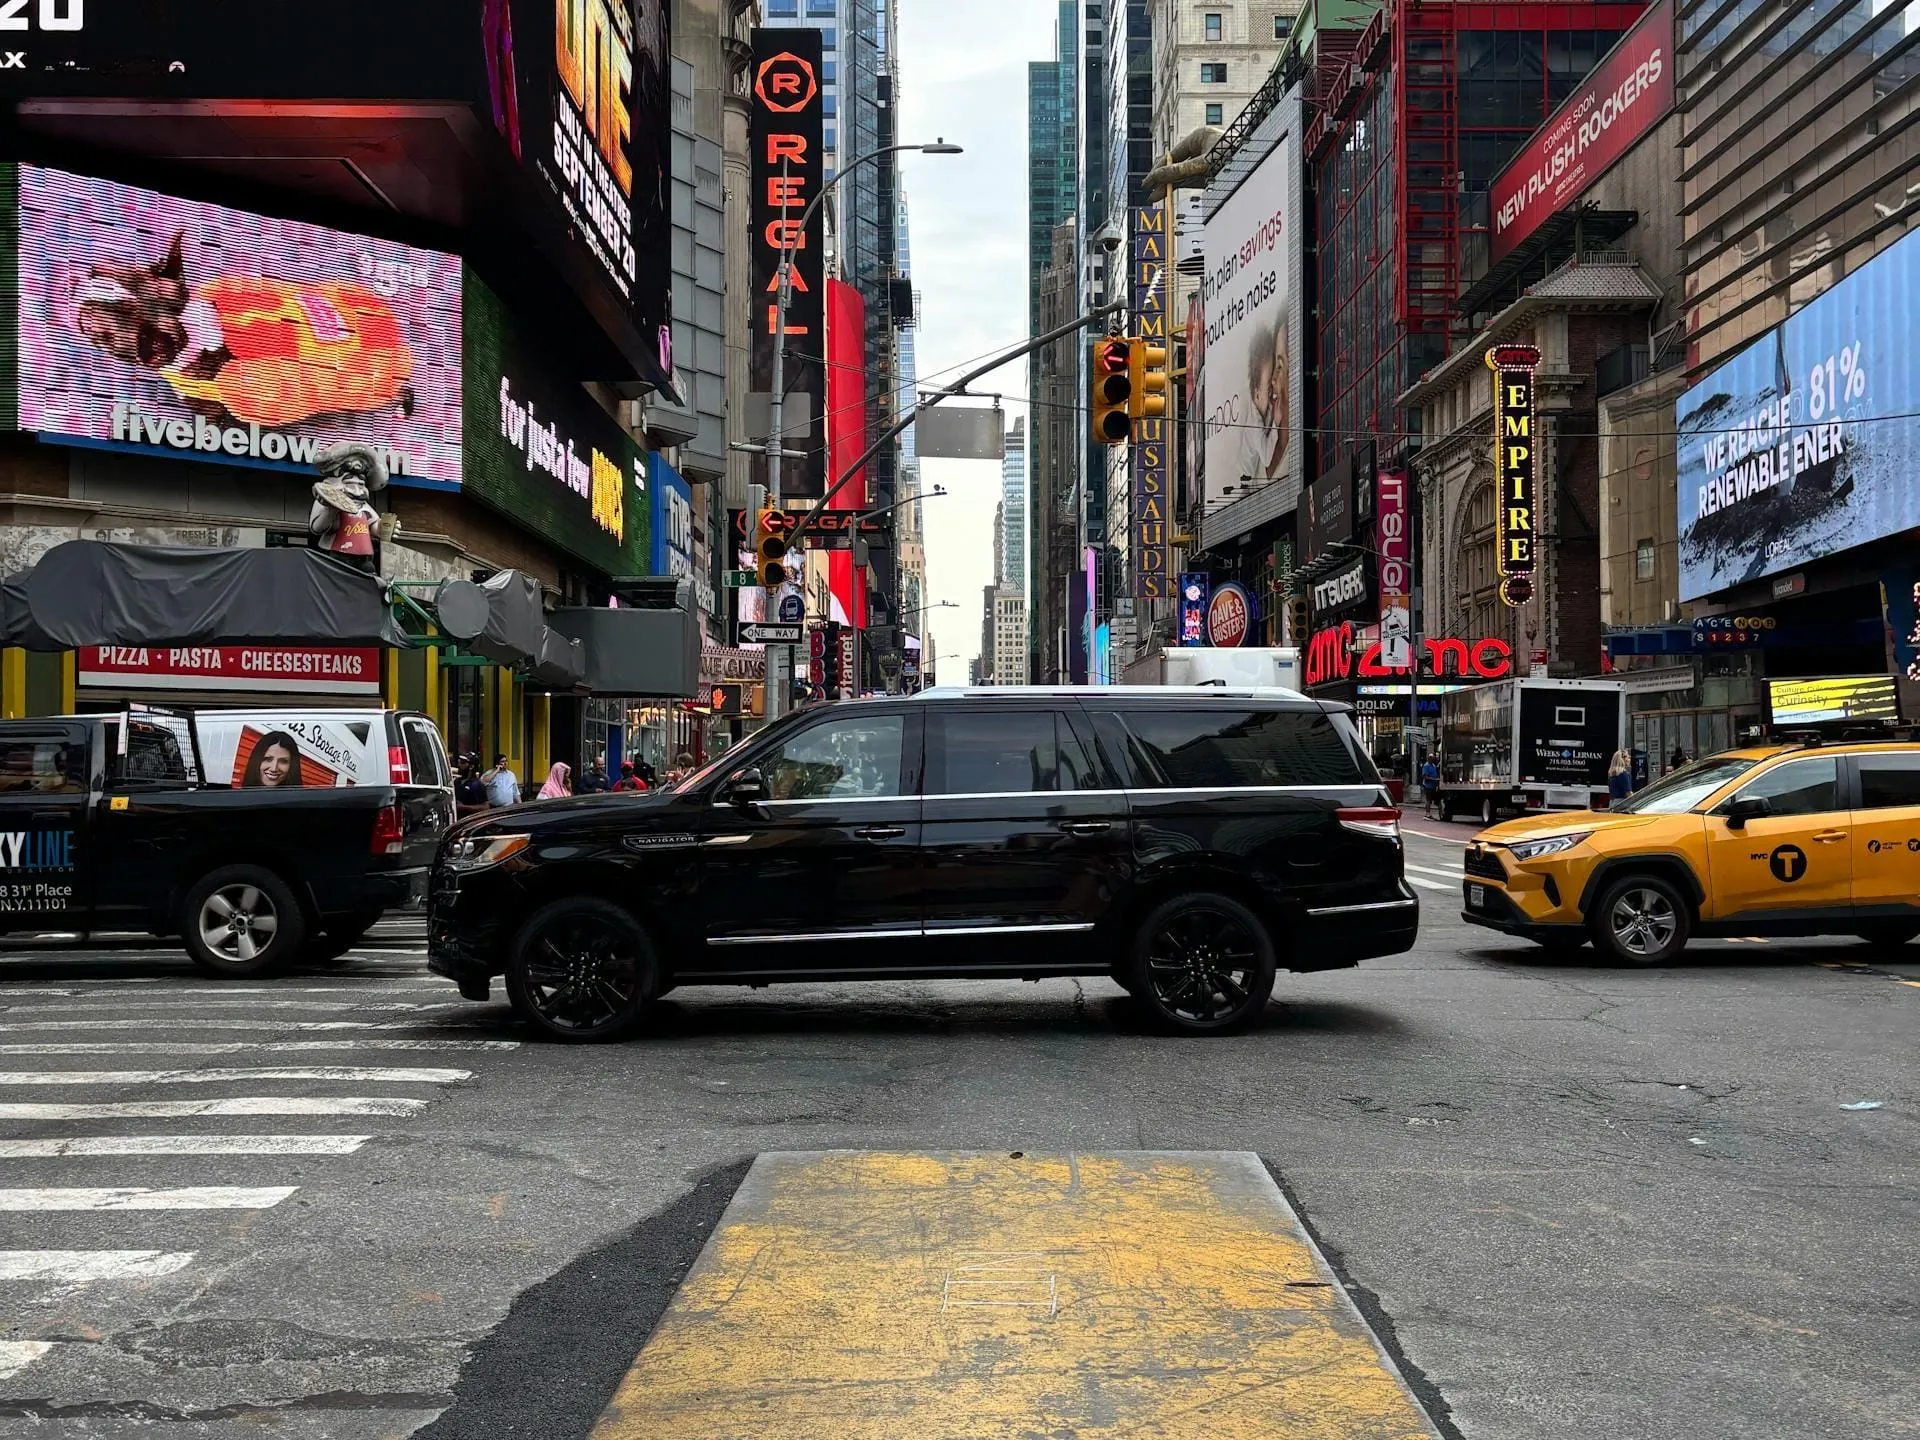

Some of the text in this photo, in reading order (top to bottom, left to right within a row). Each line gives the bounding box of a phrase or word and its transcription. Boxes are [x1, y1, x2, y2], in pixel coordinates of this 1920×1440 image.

[1496, 183, 1527, 235] NEW
[1528, 136, 1576, 204] PLUSH
[1578, 48, 1663, 155] ROCKERS
[1543, 116, 1572, 154] COMING
[1572, 90, 1596, 123] SOON
[559, 91, 632, 236] ONLY IN THEATRES
[553, 120, 621, 261] SEPTEMBER
[621, 234, 636, 283] 20
[765, 134, 809, 335] REGAL
[1216, 254, 1237, 300] plan
[1239, 210, 1282, 269] savings
[1226, 298, 1245, 330] the
[1246, 270, 1277, 315] noise
[1704, 430, 1725, 475] WE
[1809, 339, 1866, 420] 81%
[501, 375, 526, 451] for
[526, 400, 557, 472] just
[566, 438, 590, 499] few
[1505, 385, 1531, 562] EMPIRE
[1699, 441, 1790, 519] RENEWABLE
[1141, 419, 1163, 597] USSAUDS
[176, 530, 206, 540] FRESH
[747, 629, 795, 639] ONE WAY
[1212, 598, 1243, 627] DAVE &
[1213, 615, 1245, 643] BUSTER'S
[1696, 618, 1704, 628] A
[1710, 618, 1718, 628] C
[1724, 618, 1731, 628] E
[1738, 618, 1746, 628] N
[1767, 618, 1774, 628] R
[1696, 633, 1760, 642] S 1 2 3 7
[98, 646, 362, 675] PIZZA PASTA CHEESESTEAKS
[725, 659, 766, 678] GUYS
[841, 634, 854, 686] target
[1306, 620, 1352, 685] amc
[1357, 701, 1395, 710] DOLBY
[307, 724, 341, 763] Storage
[638, 836, 695, 844] NAVIGATOR
[1777, 852, 1798, 877] T
[35, 884, 72, 897] Place
